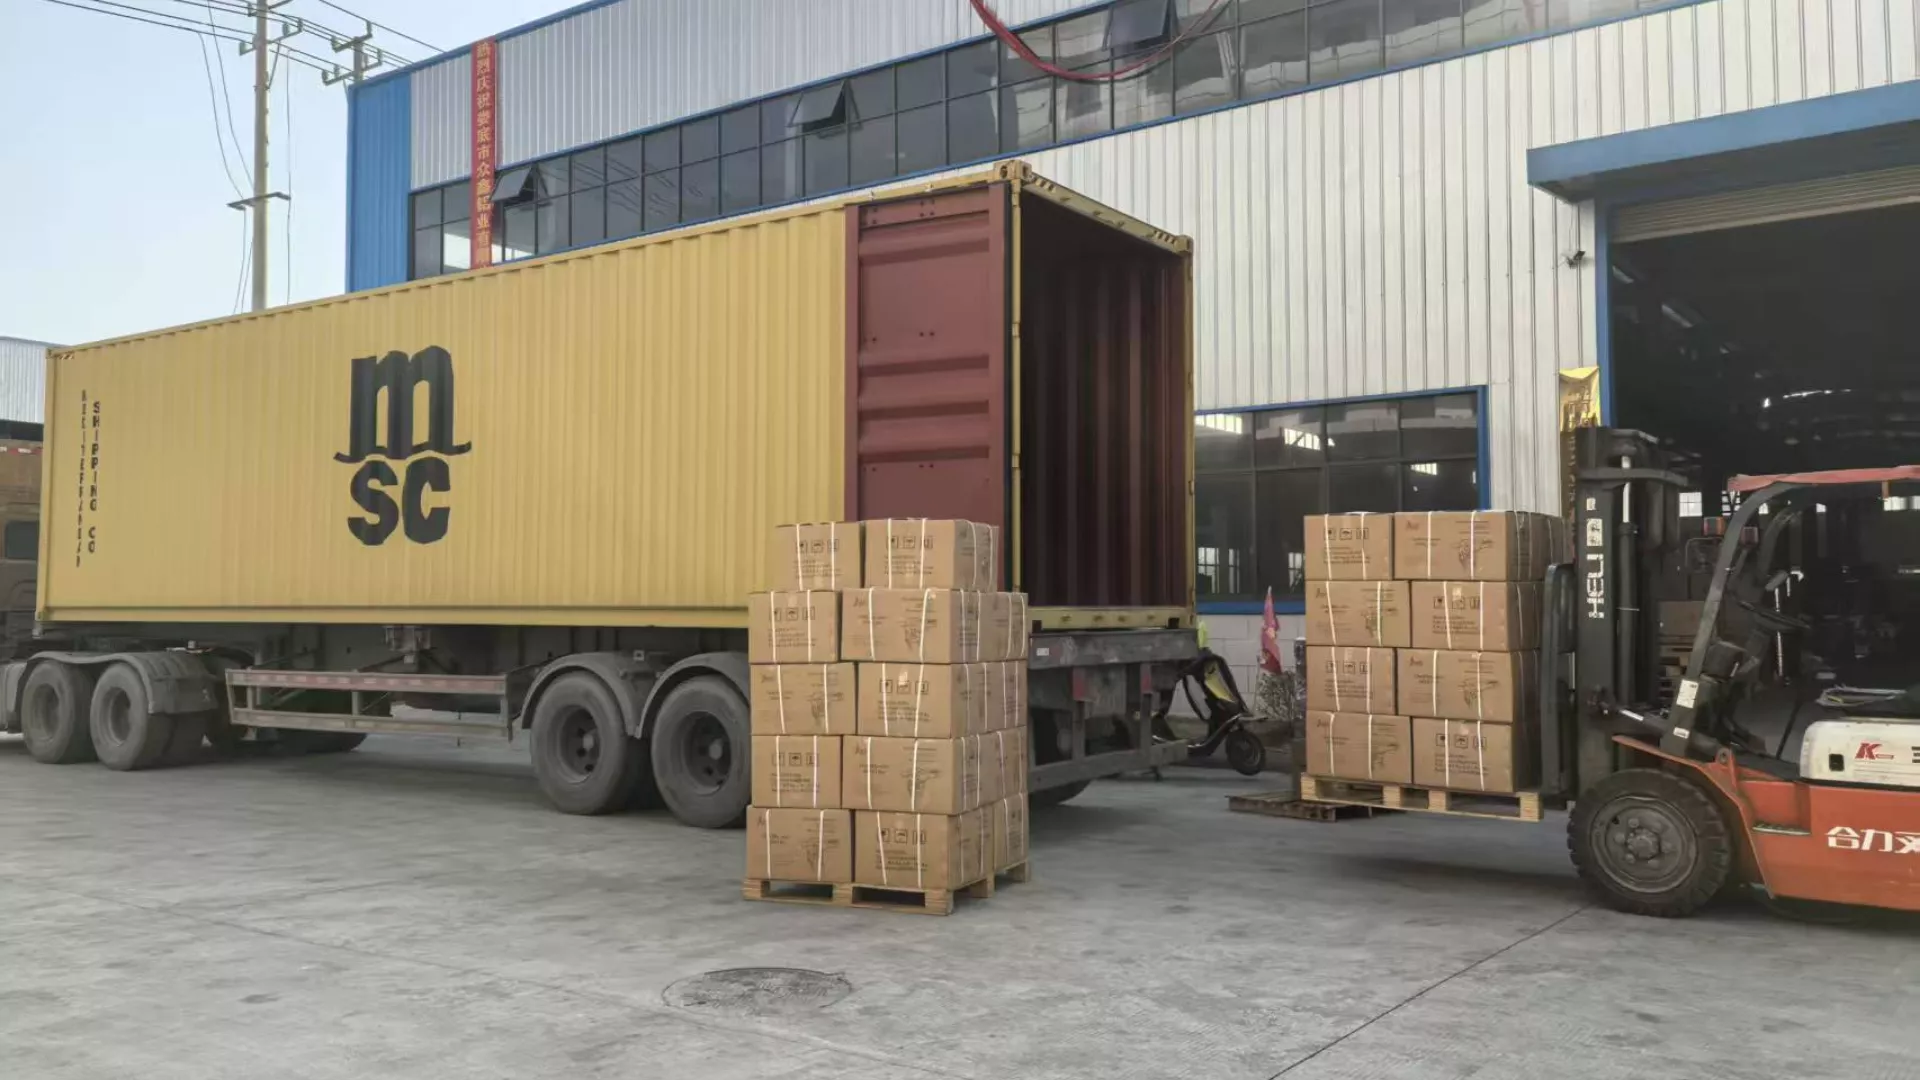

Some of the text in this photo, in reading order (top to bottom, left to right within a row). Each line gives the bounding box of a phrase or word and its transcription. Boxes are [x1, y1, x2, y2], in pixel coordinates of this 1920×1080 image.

[88, 400, 101, 553] SHIPPING CO
[1586, 553, 1605, 619] HELI
